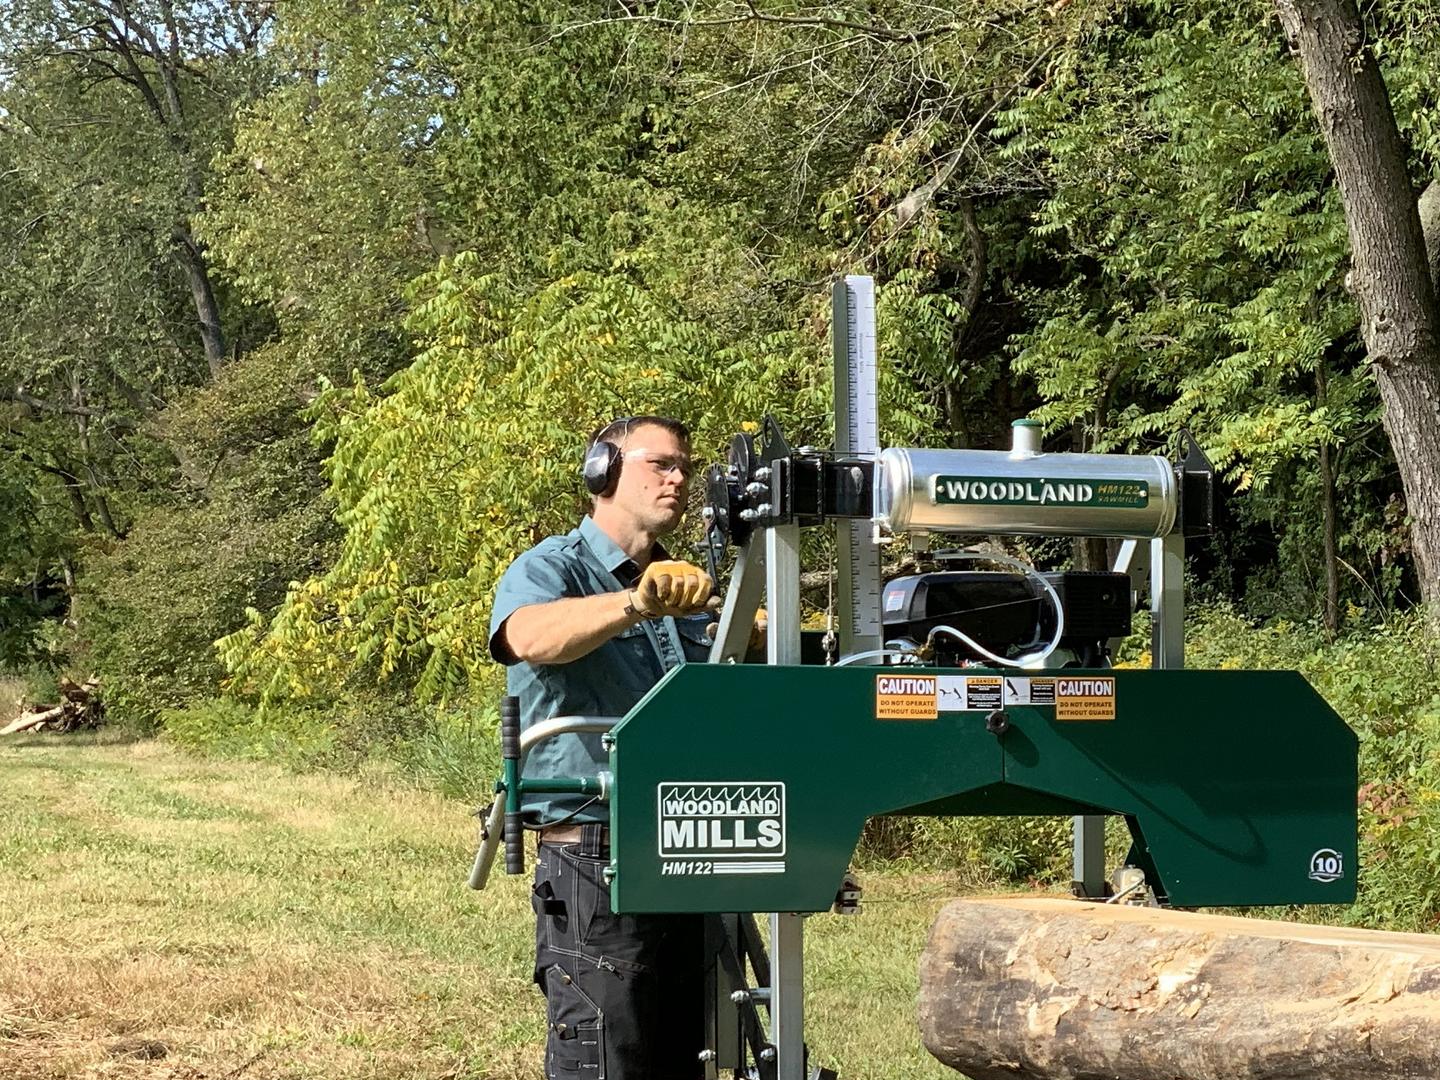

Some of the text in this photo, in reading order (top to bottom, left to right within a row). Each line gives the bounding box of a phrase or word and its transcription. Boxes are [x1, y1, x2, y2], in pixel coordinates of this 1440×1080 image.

[946, 481, 1092, 502] WOODLAND
[1098, 484, 1140, 495] HM122
[879, 679, 935, 694] CAUTION
[1058, 681, 1112, 696] CAUTION
[666, 800, 777, 815] WOODLAND
[663, 819, 782, 848] MILLS
[661, 862, 713, 875] HM122
[1315, 857, 1338, 874] 10
